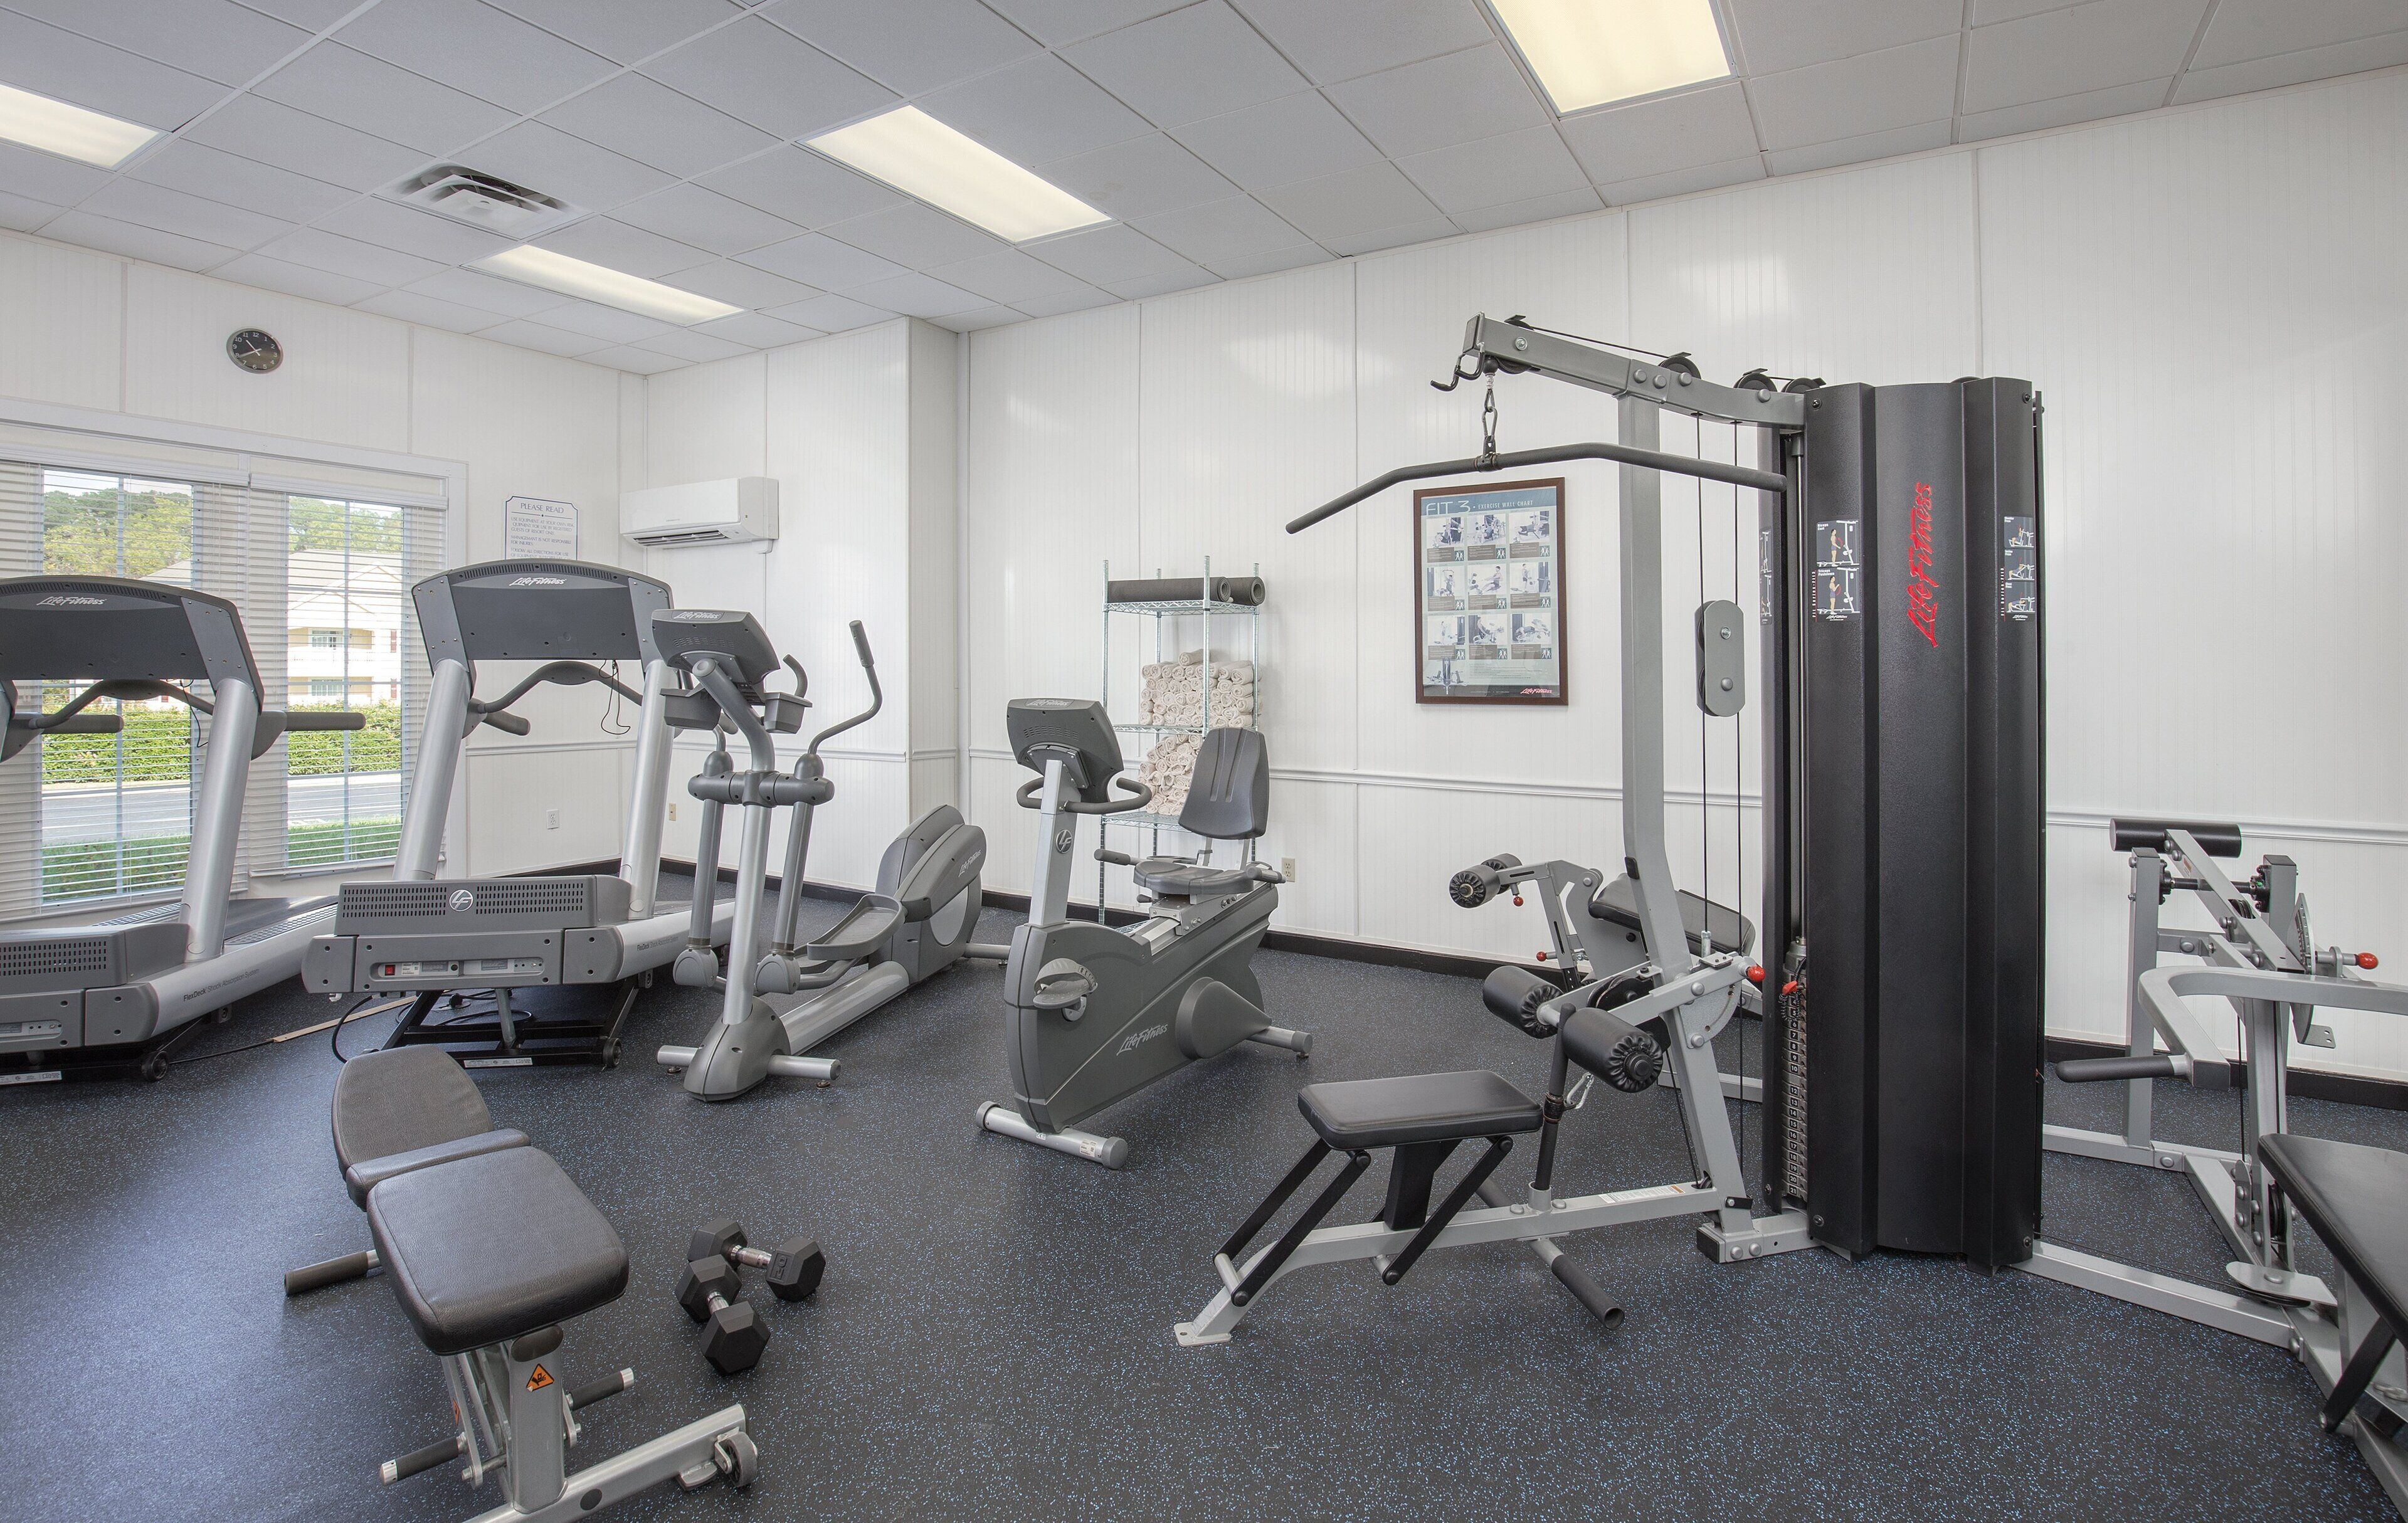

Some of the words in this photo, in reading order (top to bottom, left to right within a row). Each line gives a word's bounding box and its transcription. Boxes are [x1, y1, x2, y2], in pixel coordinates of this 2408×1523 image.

[520, 503, 543, 511] PLEASE
[546, 505, 564, 514] READ
[1426, 501, 1454, 515] FIT
[1457, 500, 1471, 514] 3
[183, 988, 206, 1002] FlexDeck
[208, 983, 222, 993] Shock
